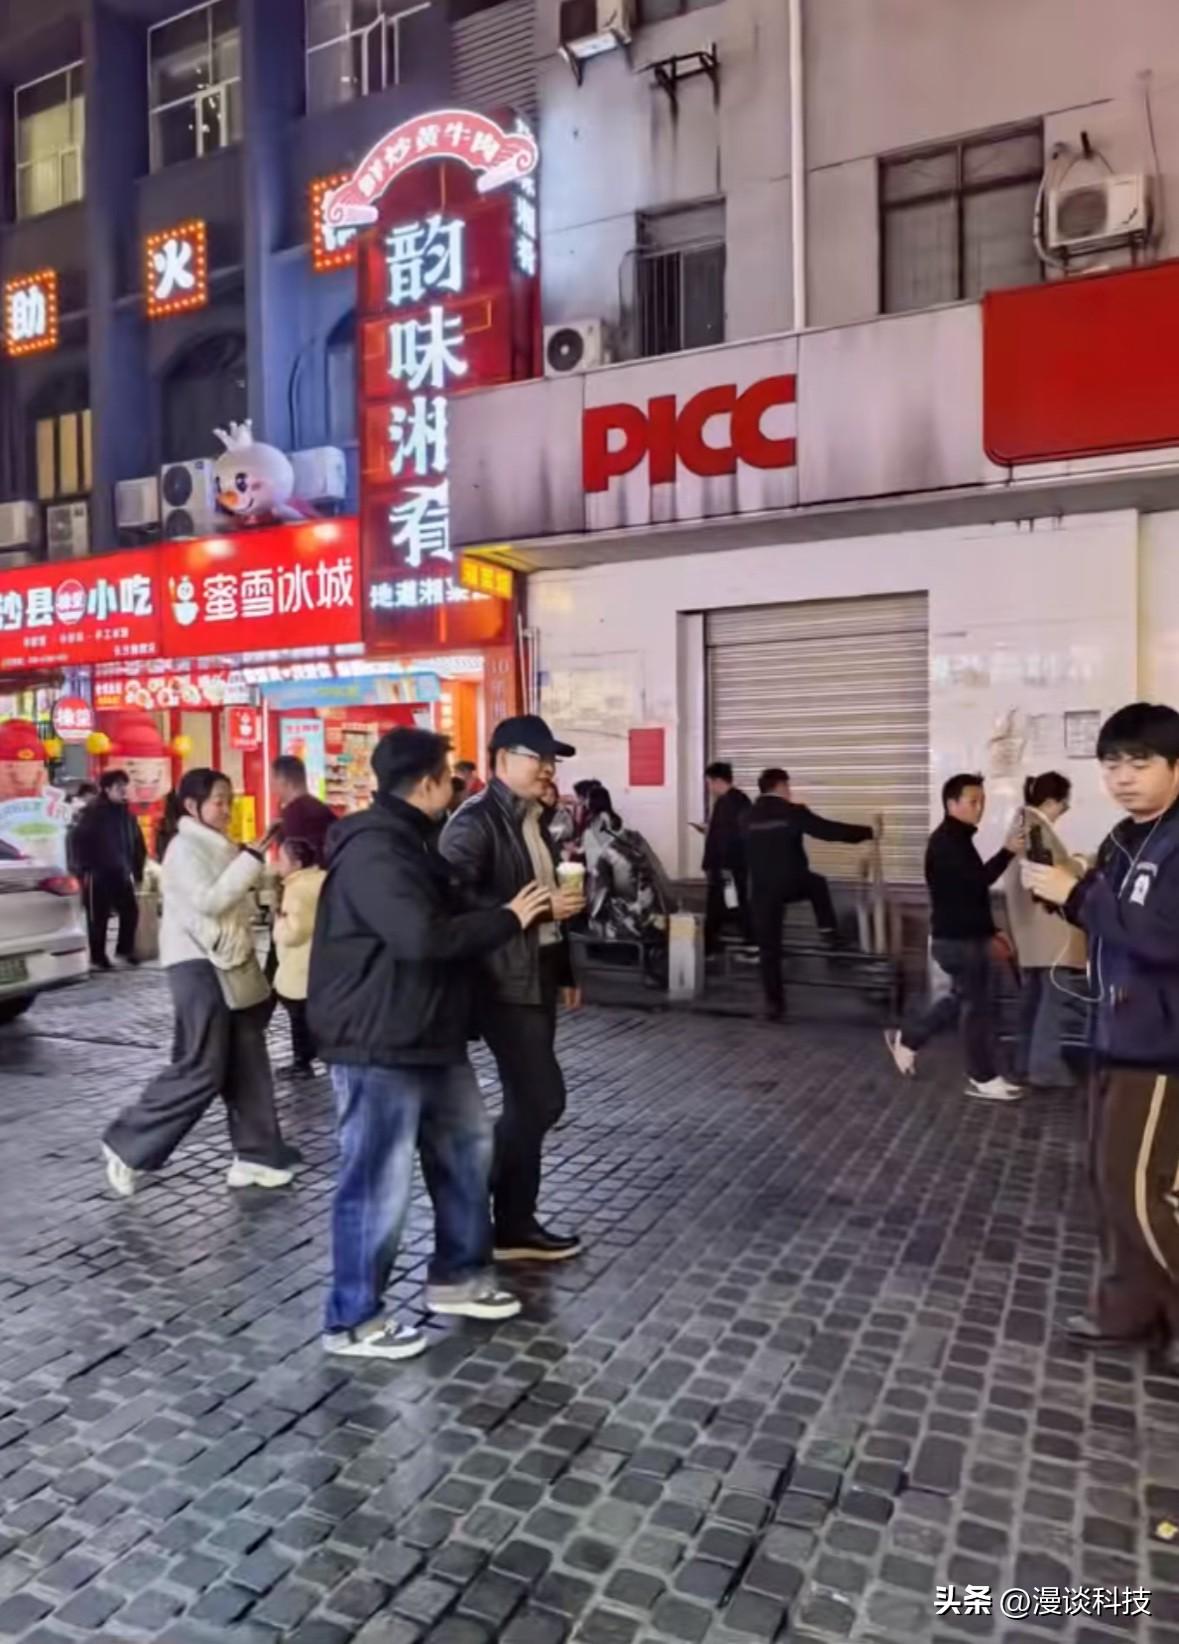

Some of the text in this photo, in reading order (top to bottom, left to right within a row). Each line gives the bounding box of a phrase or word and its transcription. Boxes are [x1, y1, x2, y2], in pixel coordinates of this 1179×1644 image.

[153, 238, 196, 299] 火
[582, 373, 798, 494] PICC
[87, 573, 153, 622] 小吃
[203, 556, 355, 623] 蜜雪冰城
